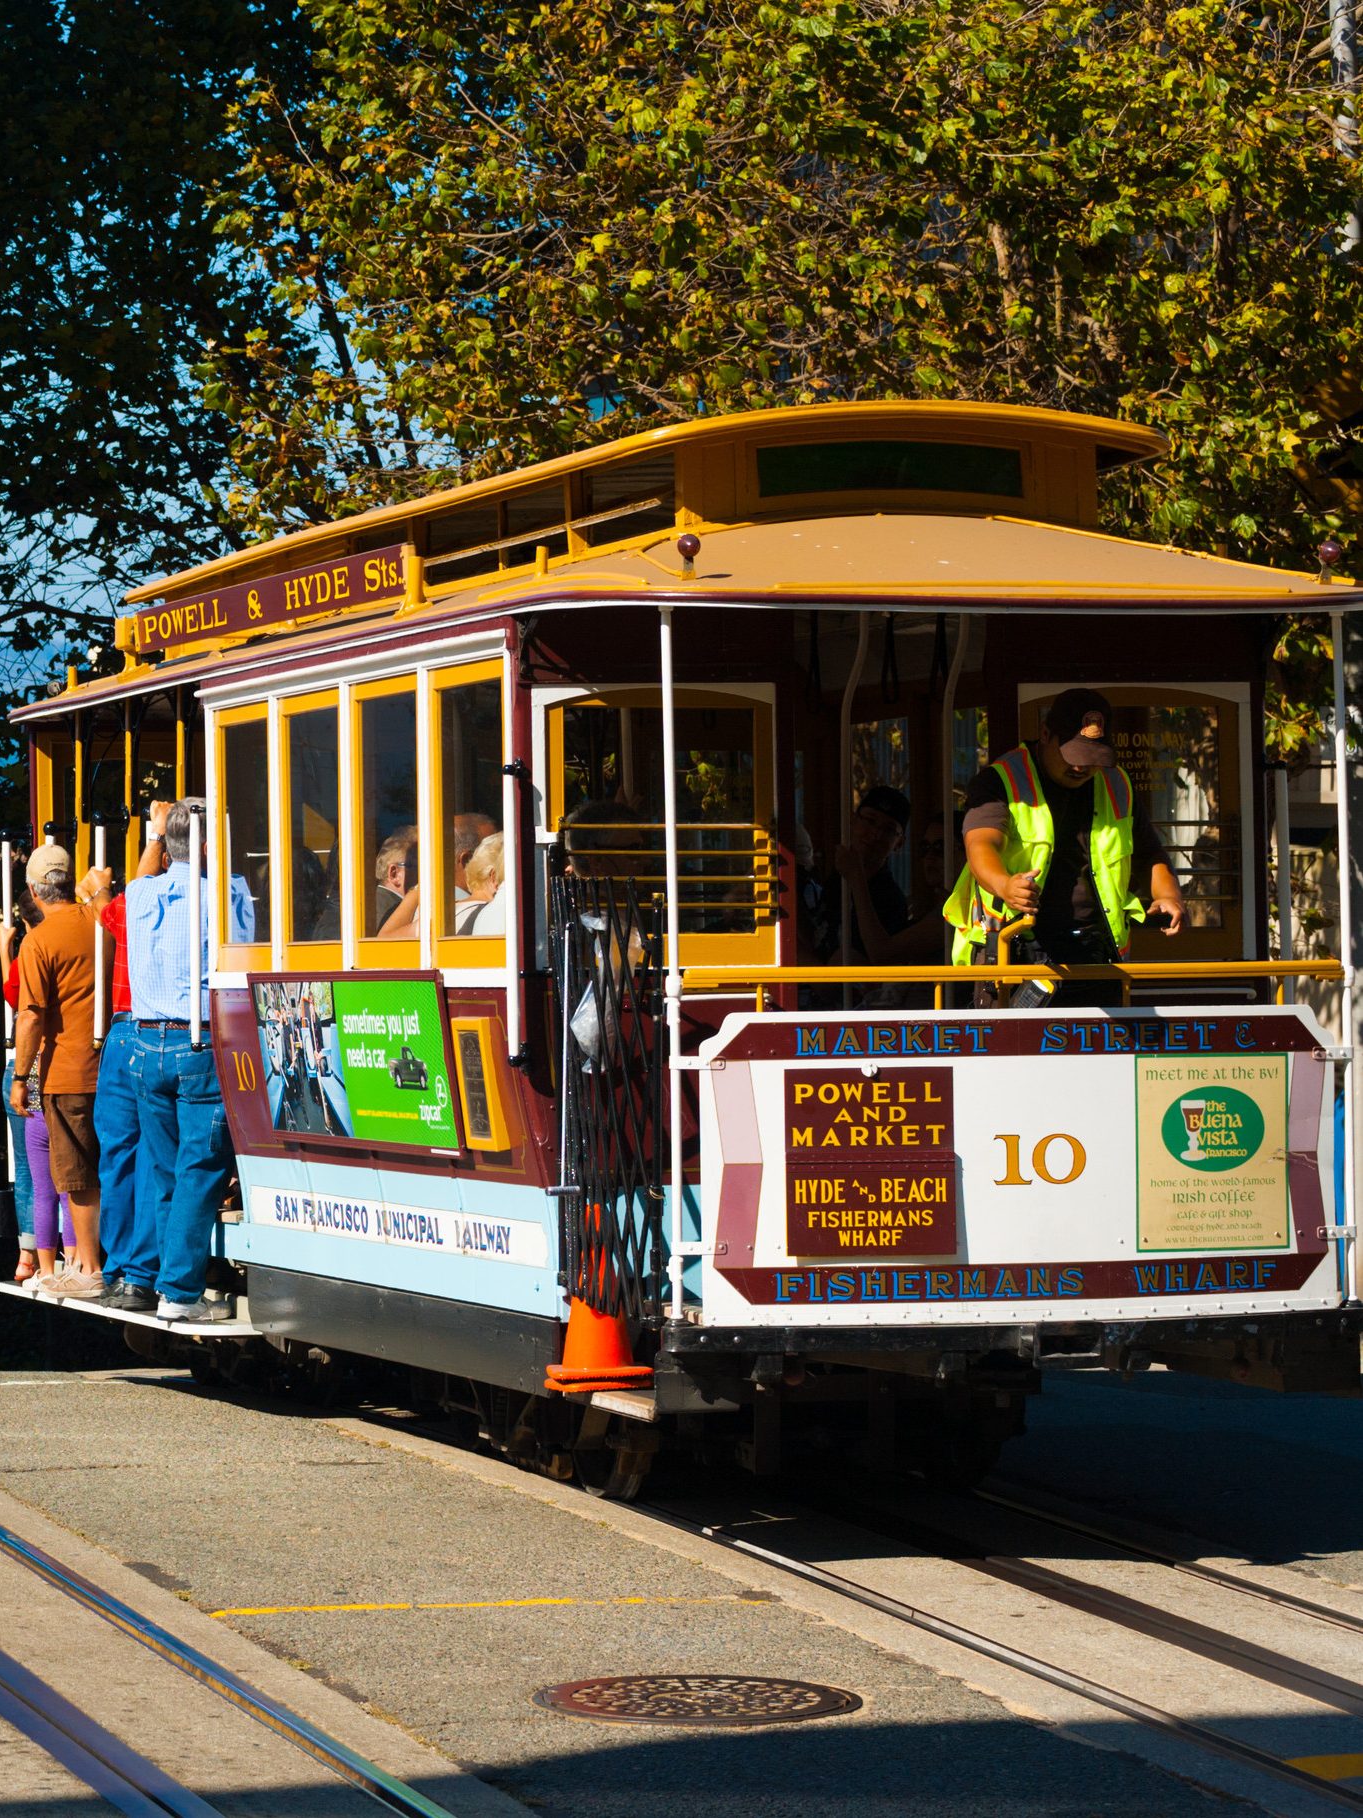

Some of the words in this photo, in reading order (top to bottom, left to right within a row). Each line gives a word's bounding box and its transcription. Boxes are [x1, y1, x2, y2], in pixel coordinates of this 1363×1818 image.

[143, 598, 228, 645] POWELL
[247, 589, 264, 621] &
[284, 566, 350, 611] HYDE
[342, 1007, 387, 1035] sometimes
[385, 1013, 403, 1042] you
[401, 1007, 421, 1042] just
[795, 1023, 994, 1056] MARKET
[1040, 1021, 1217, 1053] STREET
[346, 1041, 366, 1069] need
[366, 1048, 374, 1069] a
[372, 1048, 389, 1069] car.
[231, 1051, 257, 1092] 10
[1145, 1067, 1183, 1081] meet
[1187, 1069, 1209, 1081] me
[1212, 1067, 1228, 1080] at
[1231, 1066, 1255, 1080] the
[794, 1081, 942, 1104] POWELL
[1206, 1100, 1227, 1112] the
[418, 1098, 443, 1127] zipcar
[834, 1106, 907, 1123] AND
[792, 1125, 946, 1147] MARKET
[993, 1133, 1087, 1186] 10
[794, 1179, 846, 1205] HYDE
[852, 1180, 877, 1203] AND
[881, 1177, 947, 1203] BEACH
[1150, 1178, 1178, 1188] home
[1179, 1178, 1190, 1188] of
[1192, 1177, 1209, 1187] the
[275, 1194, 299, 1223] SAN
[302, 1198, 369, 1234] FRANCISCO
[807, 1209, 934, 1228] FISHERMANS
[1229, 1208, 1253, 1219] shop
[838, 1229, 903, 1247] WHARF
[775, 1266, 1085, 1302] FISHERMANS
[1134, 1259, 1277, 1293] WHARF
